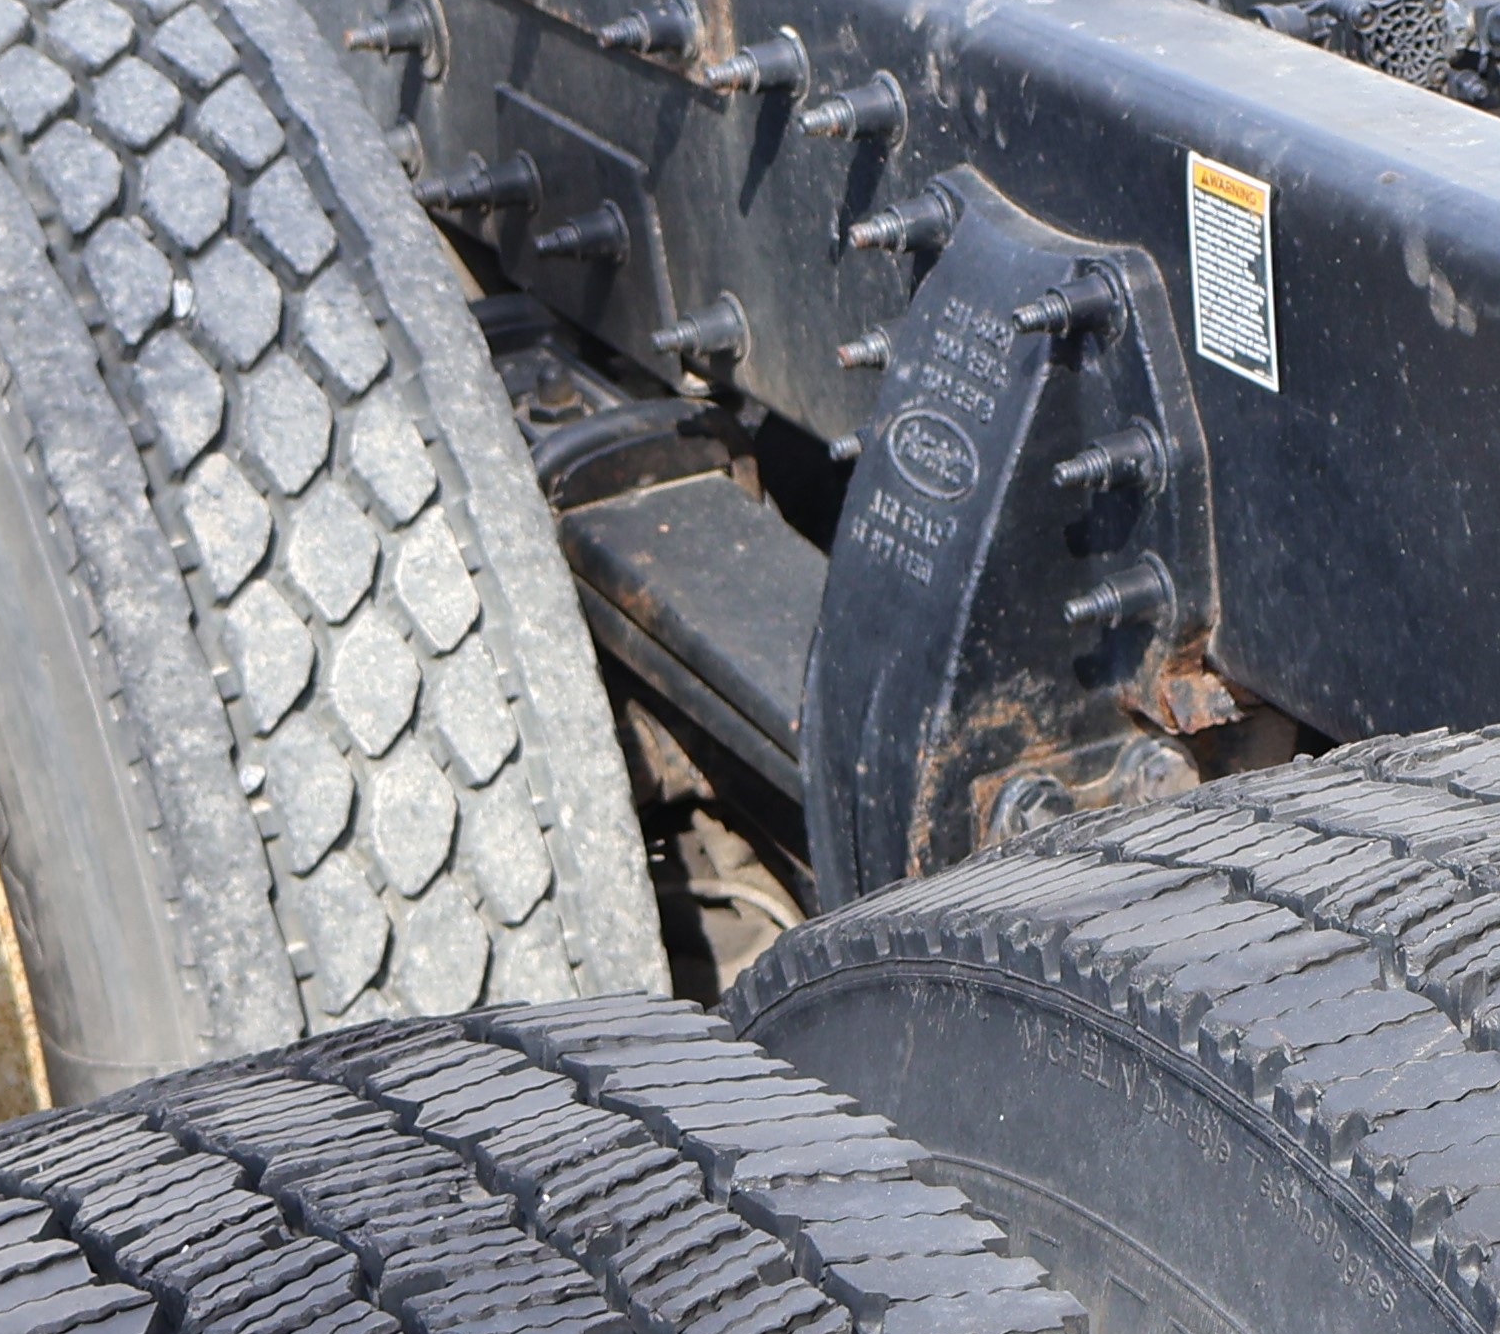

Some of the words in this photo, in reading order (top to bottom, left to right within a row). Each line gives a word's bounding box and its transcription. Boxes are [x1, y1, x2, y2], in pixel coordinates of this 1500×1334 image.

[1208, 174, 1258, 207] WARNING
[1018, 1016, 1139, 1102] MICHELIN
[1142, 1076, 1232, 1164] Durable
[1245, 1145, 1398, 1314] Technologies
